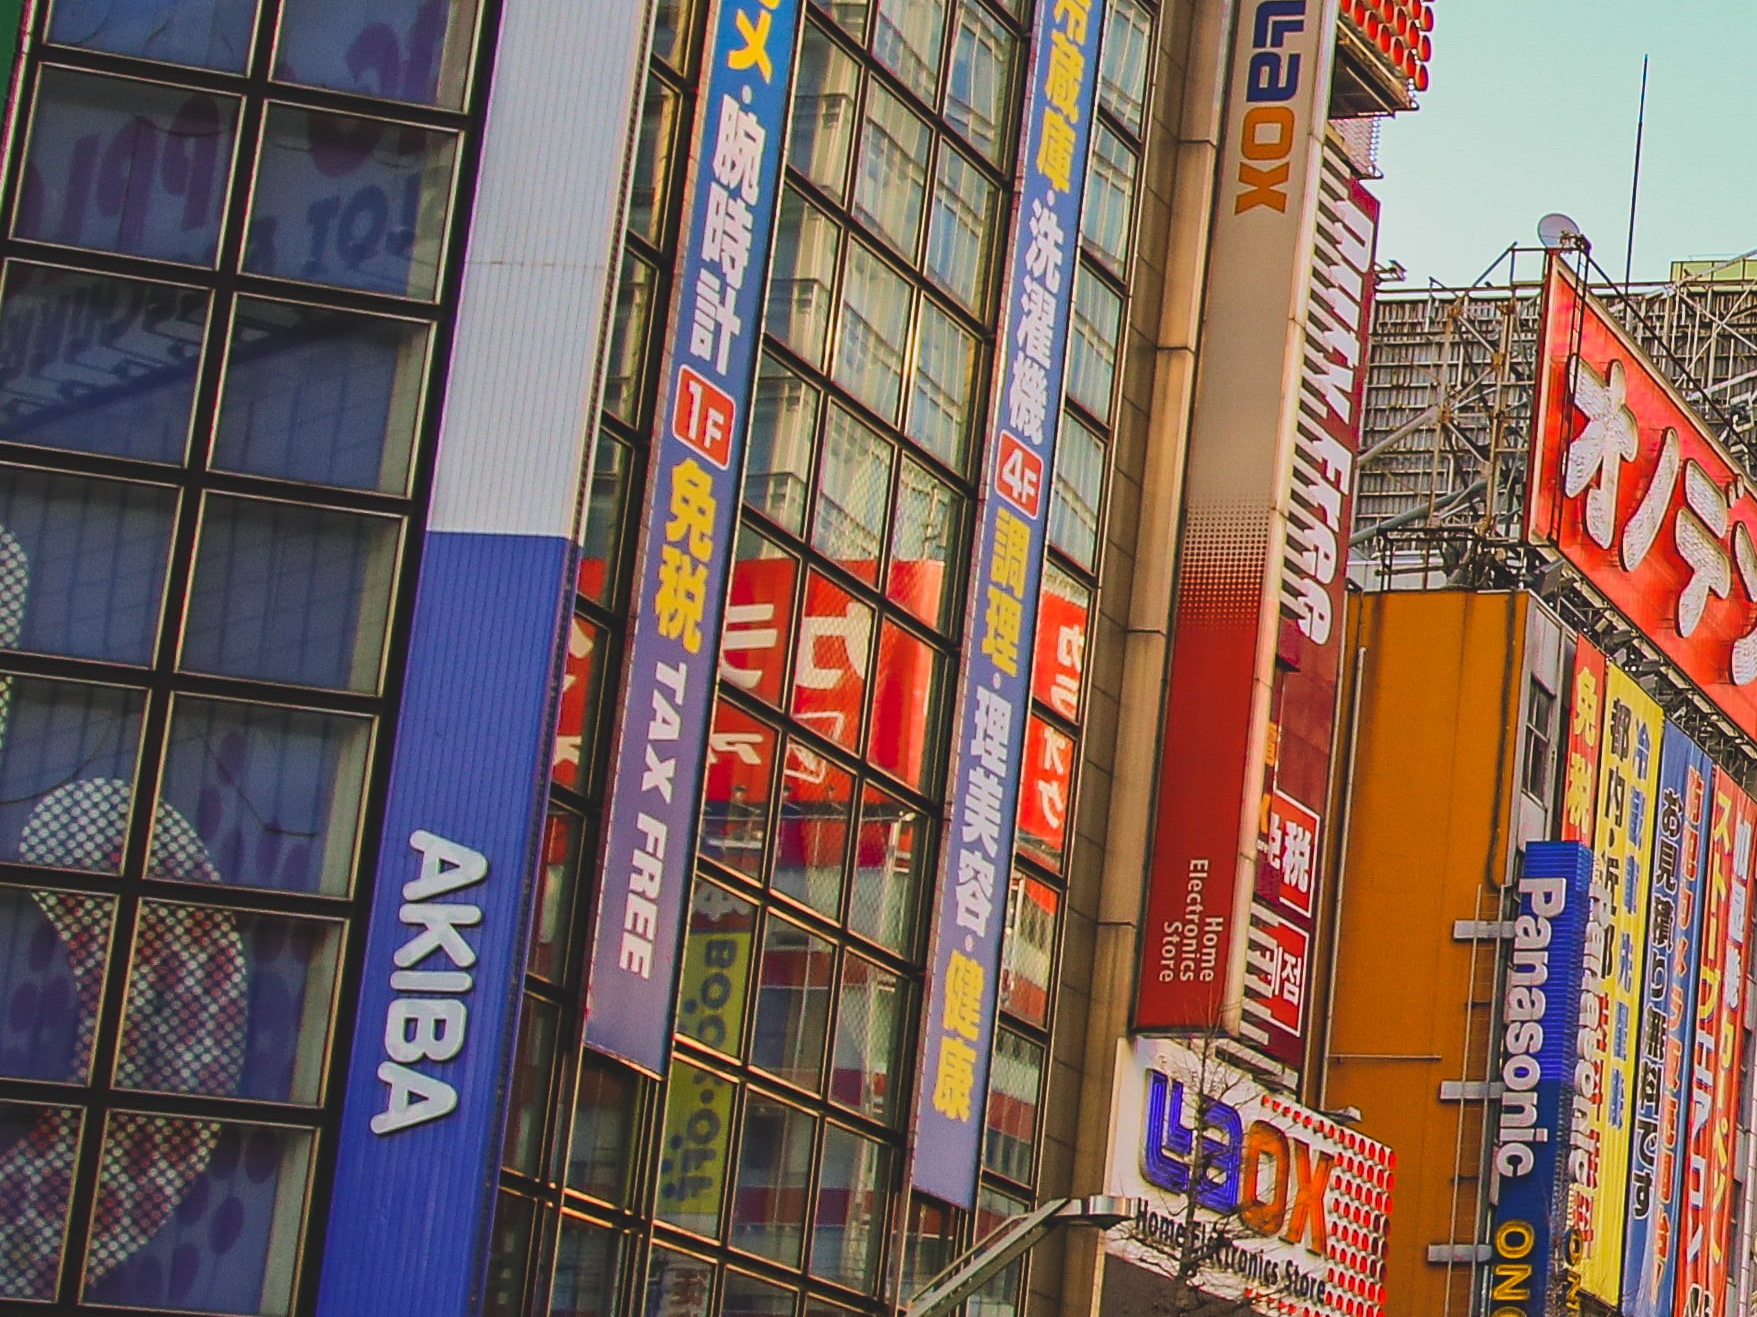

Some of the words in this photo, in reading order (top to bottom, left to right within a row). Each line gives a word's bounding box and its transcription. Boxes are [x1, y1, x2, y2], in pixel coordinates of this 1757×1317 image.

[681, 378, 726, 458] 1F
[1000, 440, 1038, 510] 4F
[651, 448, 721, 659] 免税
[641, 649, 689, 806] TAX
[617, 806, 668, 981] FREE
[1159, 920, 1183, 983] Store
[1178, 858, 1209, 983] Electronics
[1199, 915, 1223, 983] Home
[370, 829, 488, 1135] AKIBA
[1497, 877, 1566, 1178] Panasonic
[1134, 1198, 1183, 1248] Home
[1283, 1254, 1327, 1307] Store
